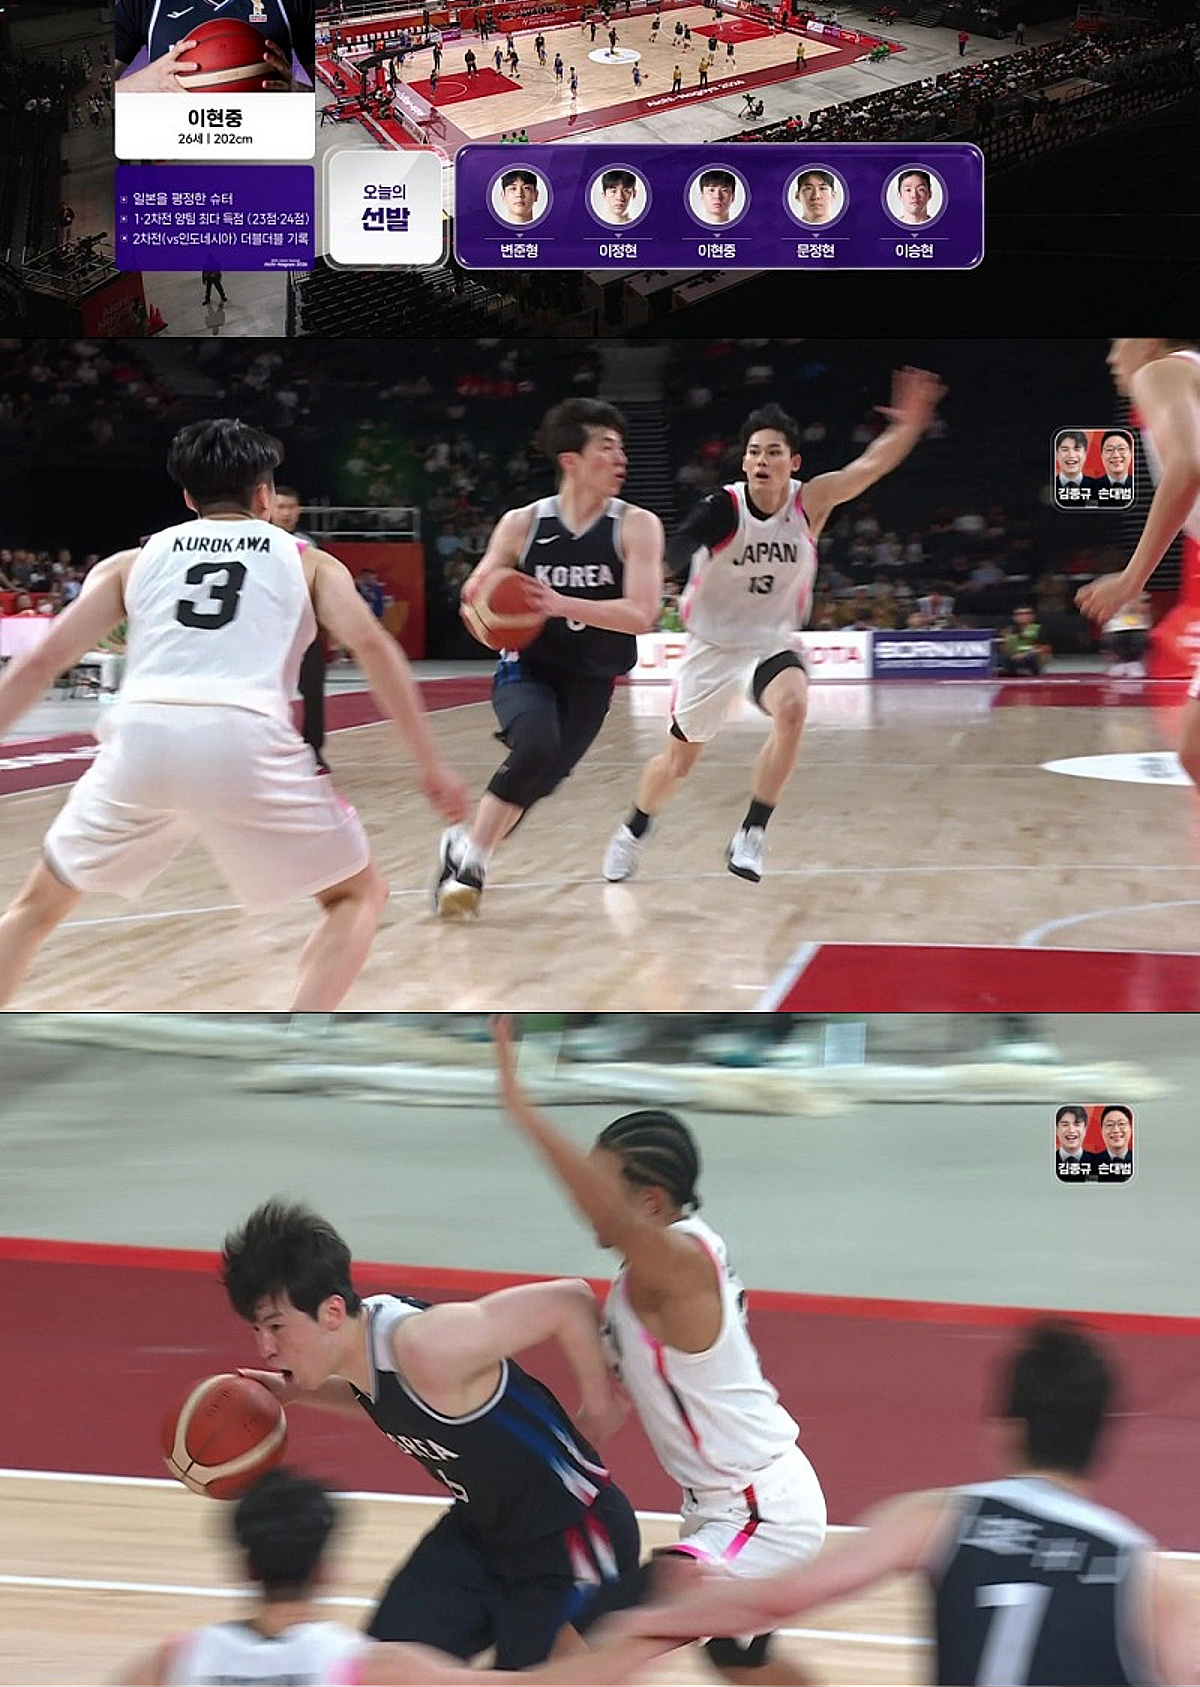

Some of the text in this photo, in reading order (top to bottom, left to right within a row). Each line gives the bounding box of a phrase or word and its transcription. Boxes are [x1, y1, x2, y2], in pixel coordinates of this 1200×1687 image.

[172, 536, 271, 555] KUROKAWA
[732, 542, 798, 567] JAPAN
[535, 563, 615, 589] KOREA
[749, 574, 774, 594] 13
[176, 561, 247, 630] 3
